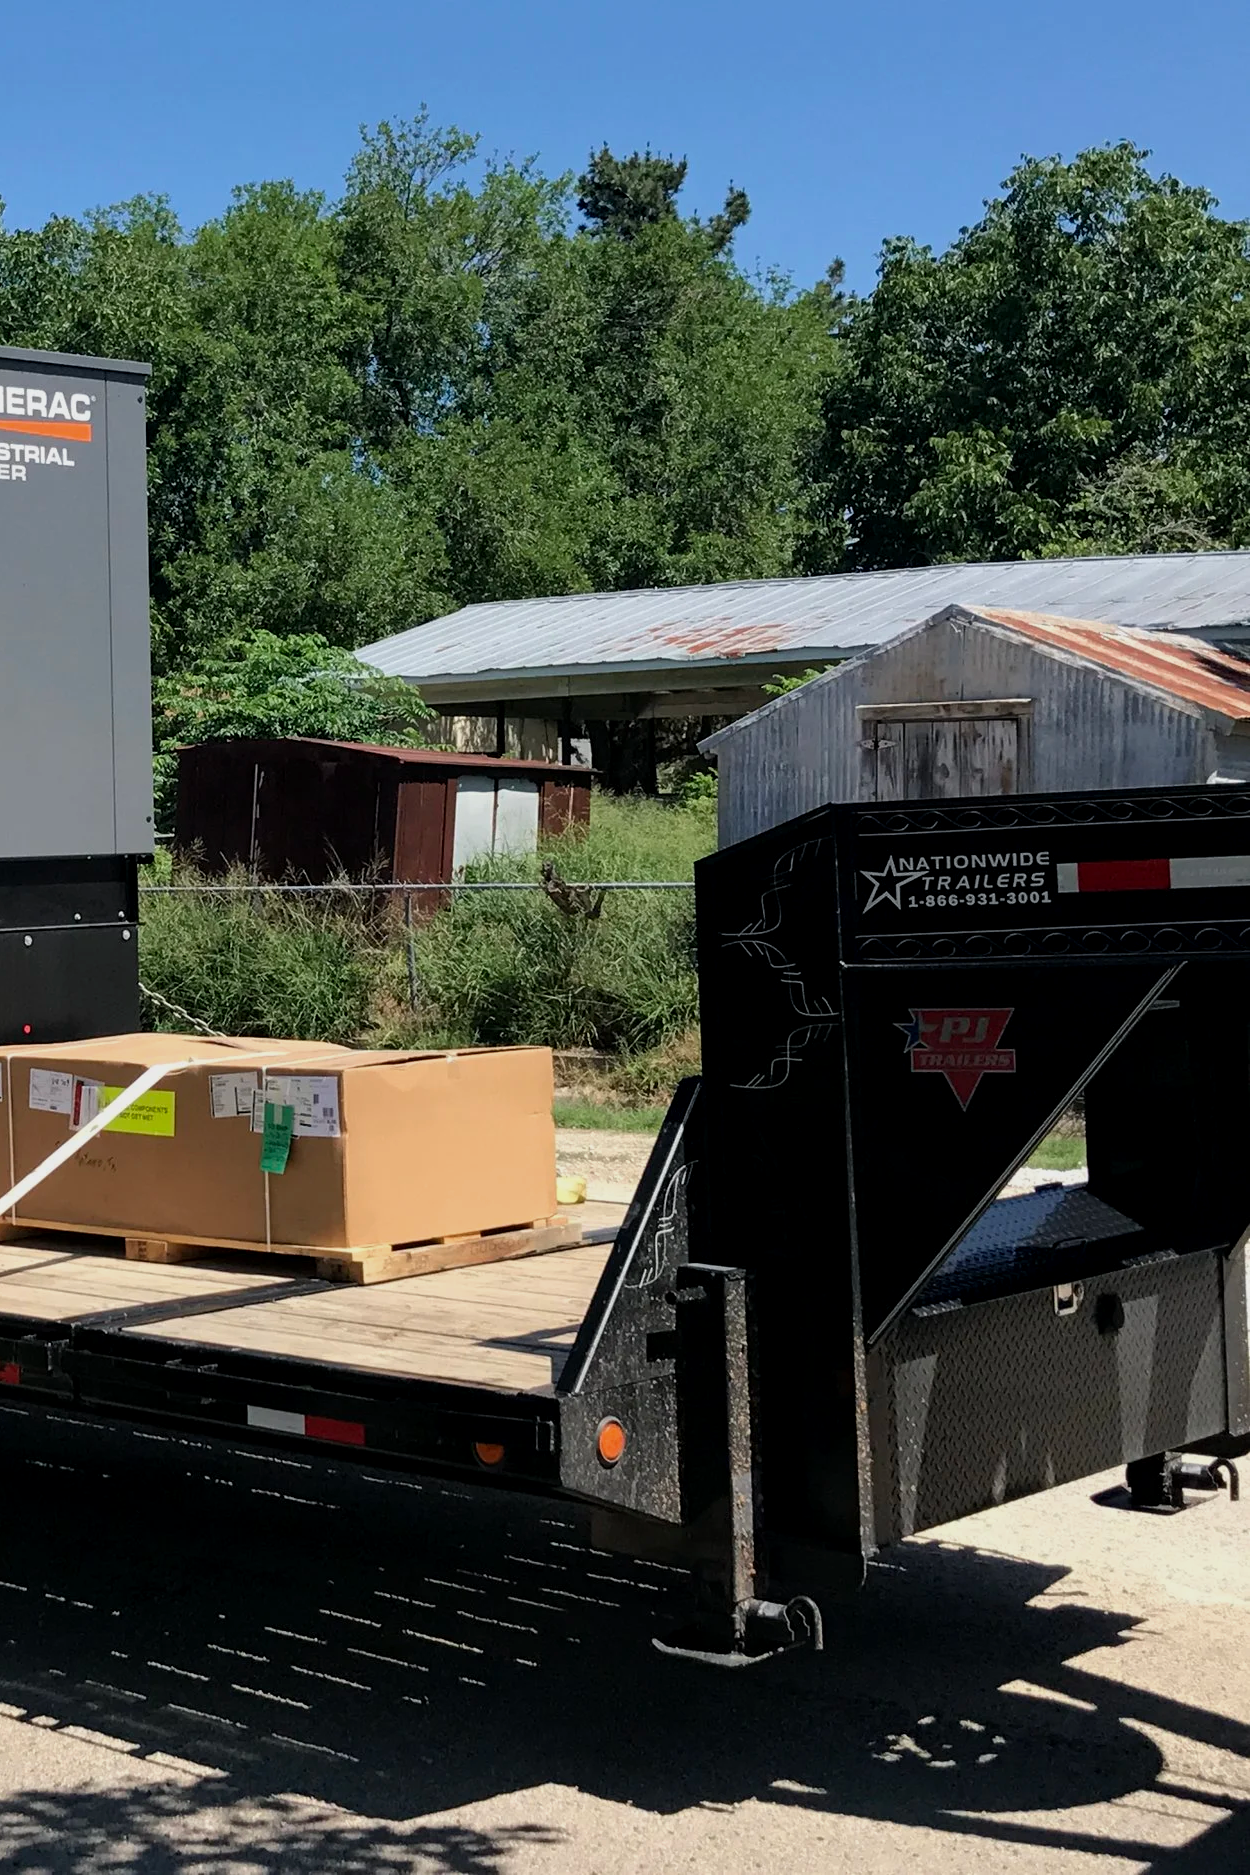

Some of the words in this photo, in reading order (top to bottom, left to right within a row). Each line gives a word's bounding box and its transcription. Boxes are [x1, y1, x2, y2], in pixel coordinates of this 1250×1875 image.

[899, 852, 1049, 871] NATIONWIDE
[923, 871, 1046, 890] TRAILERS
[908, 891, 1052, 908] 1-866-931-3001
[939, 1016, 990, 1043] PJ
[919, 1053, 1011, 1068] TRAILERS
